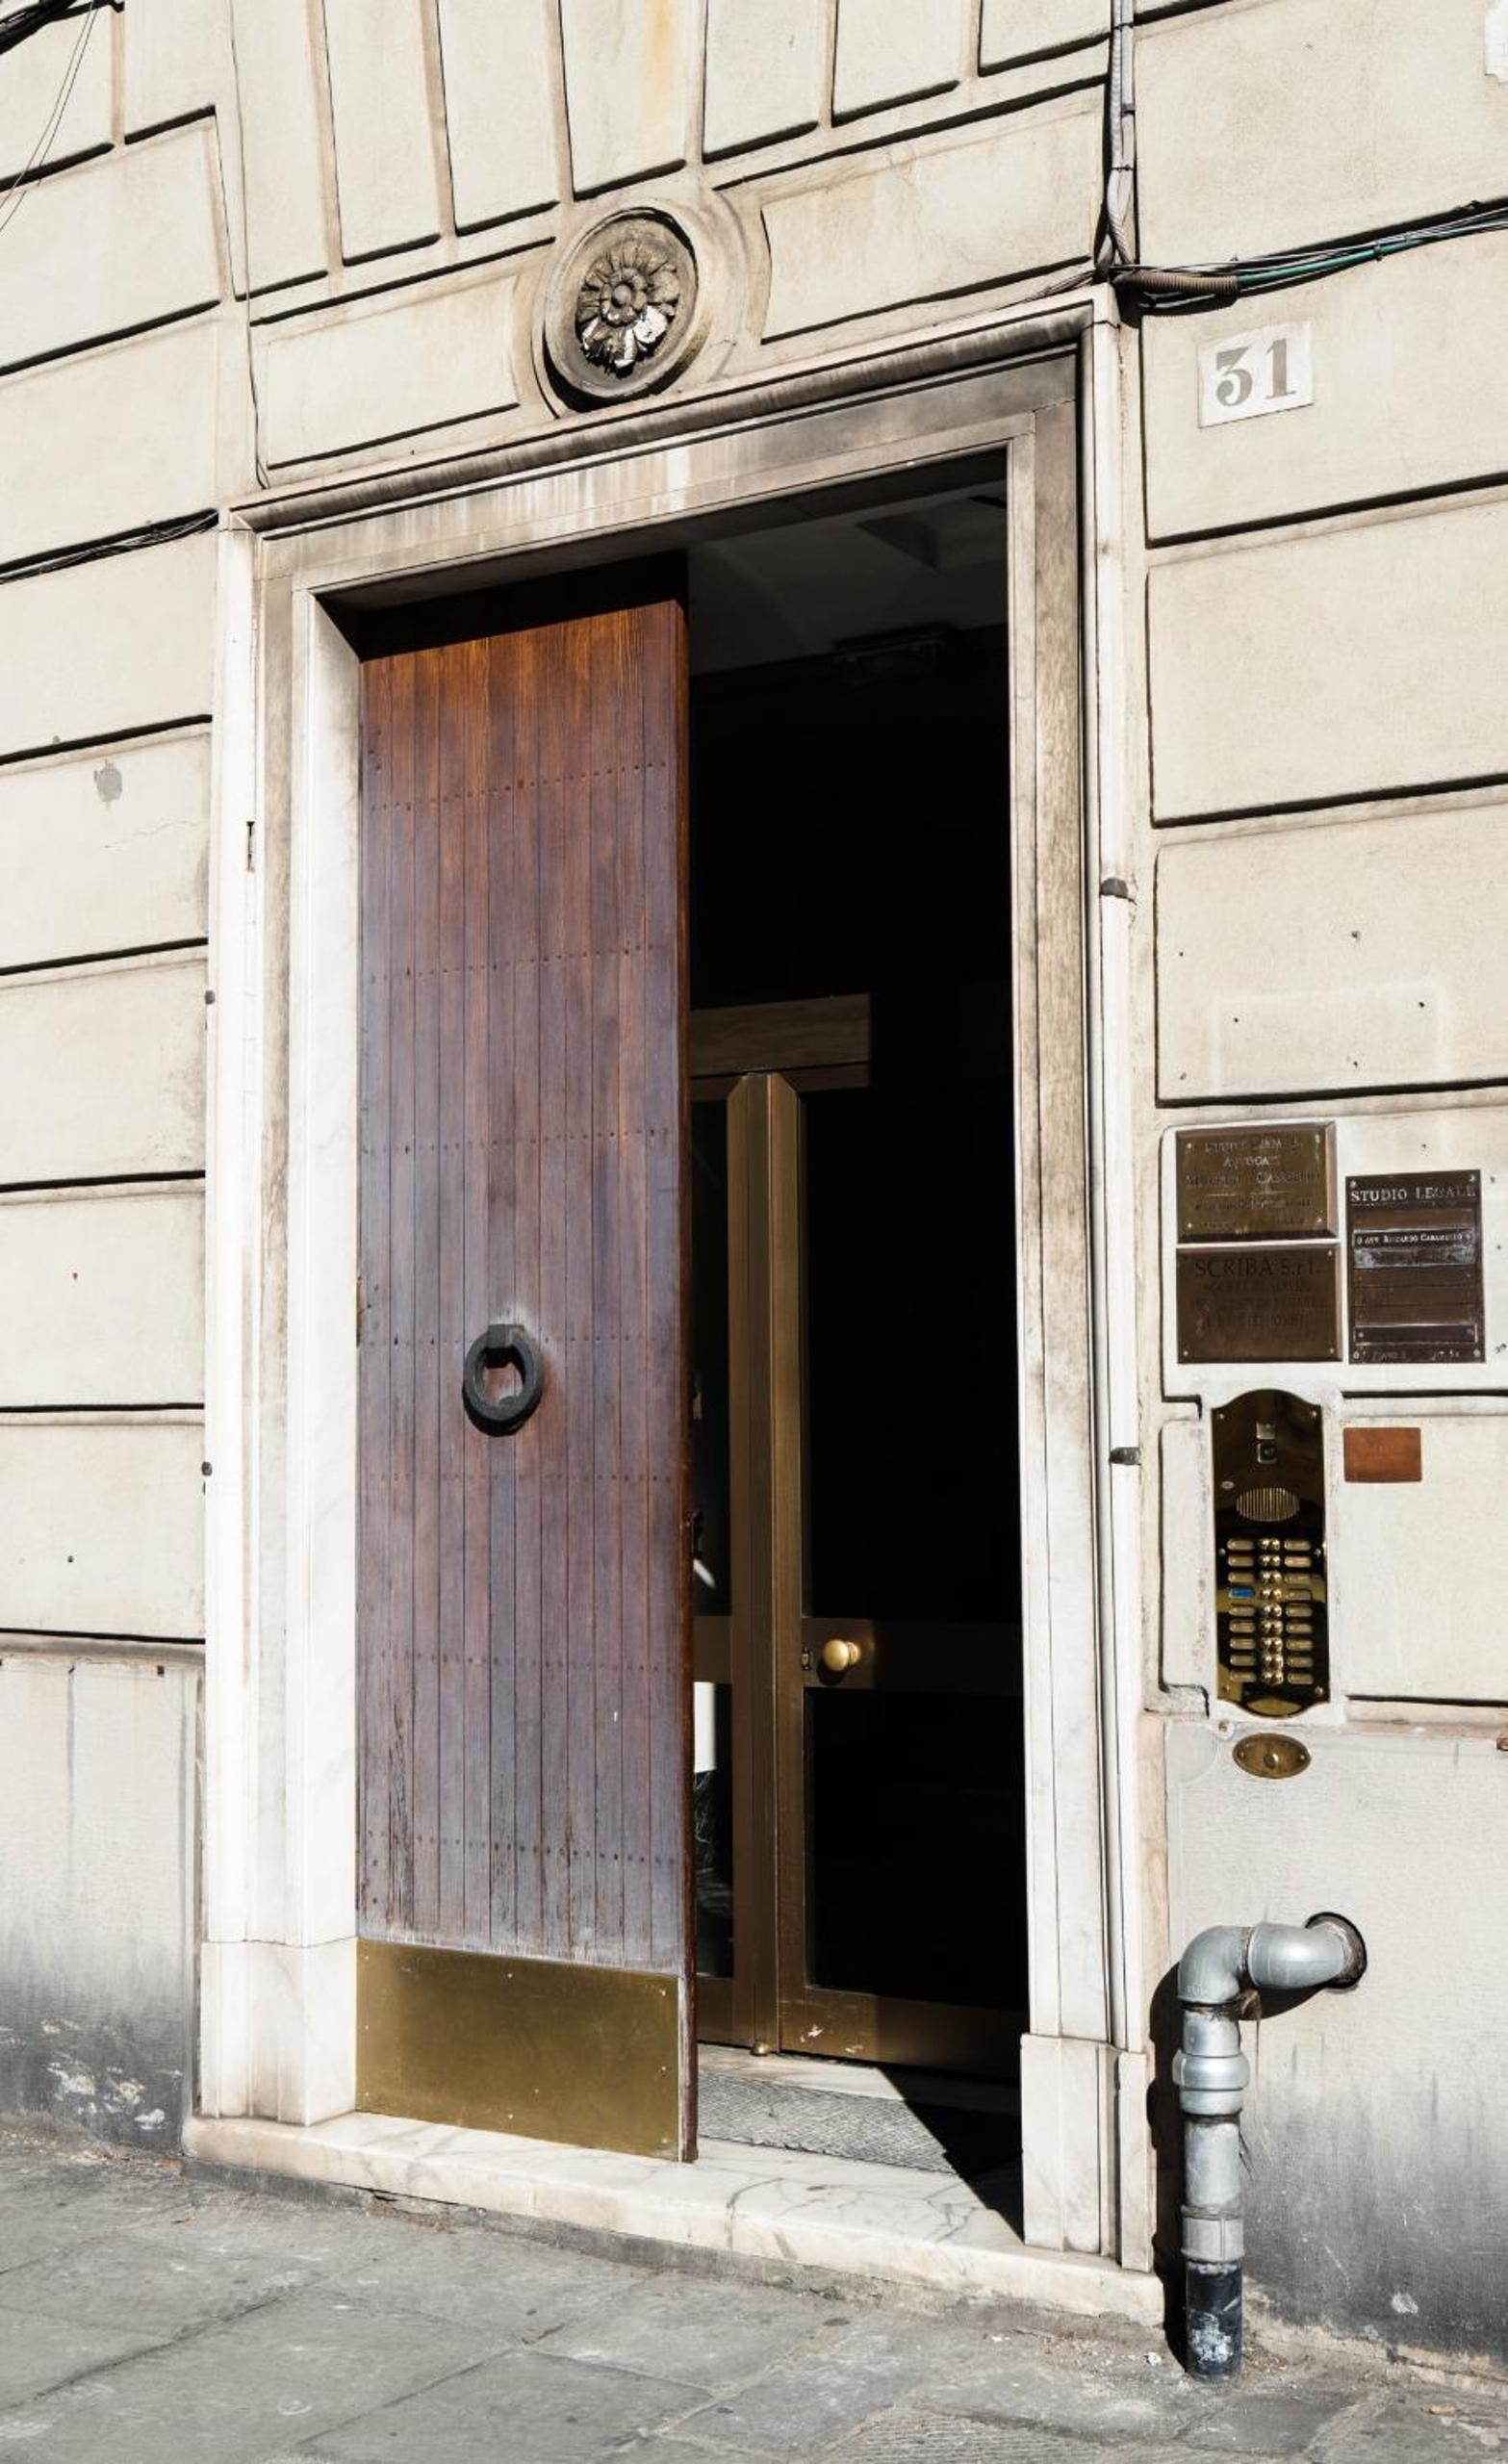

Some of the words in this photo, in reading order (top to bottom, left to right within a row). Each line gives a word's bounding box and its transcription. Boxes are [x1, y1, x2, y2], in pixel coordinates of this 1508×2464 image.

[1215, 338, 1297, 407] 31
[1350, 1187, 1408, 1202] STUDIO
[1416, 1184, 1476, 1199] LEGALE
[1194, 1256, 1274, 1278] SCRIBA
